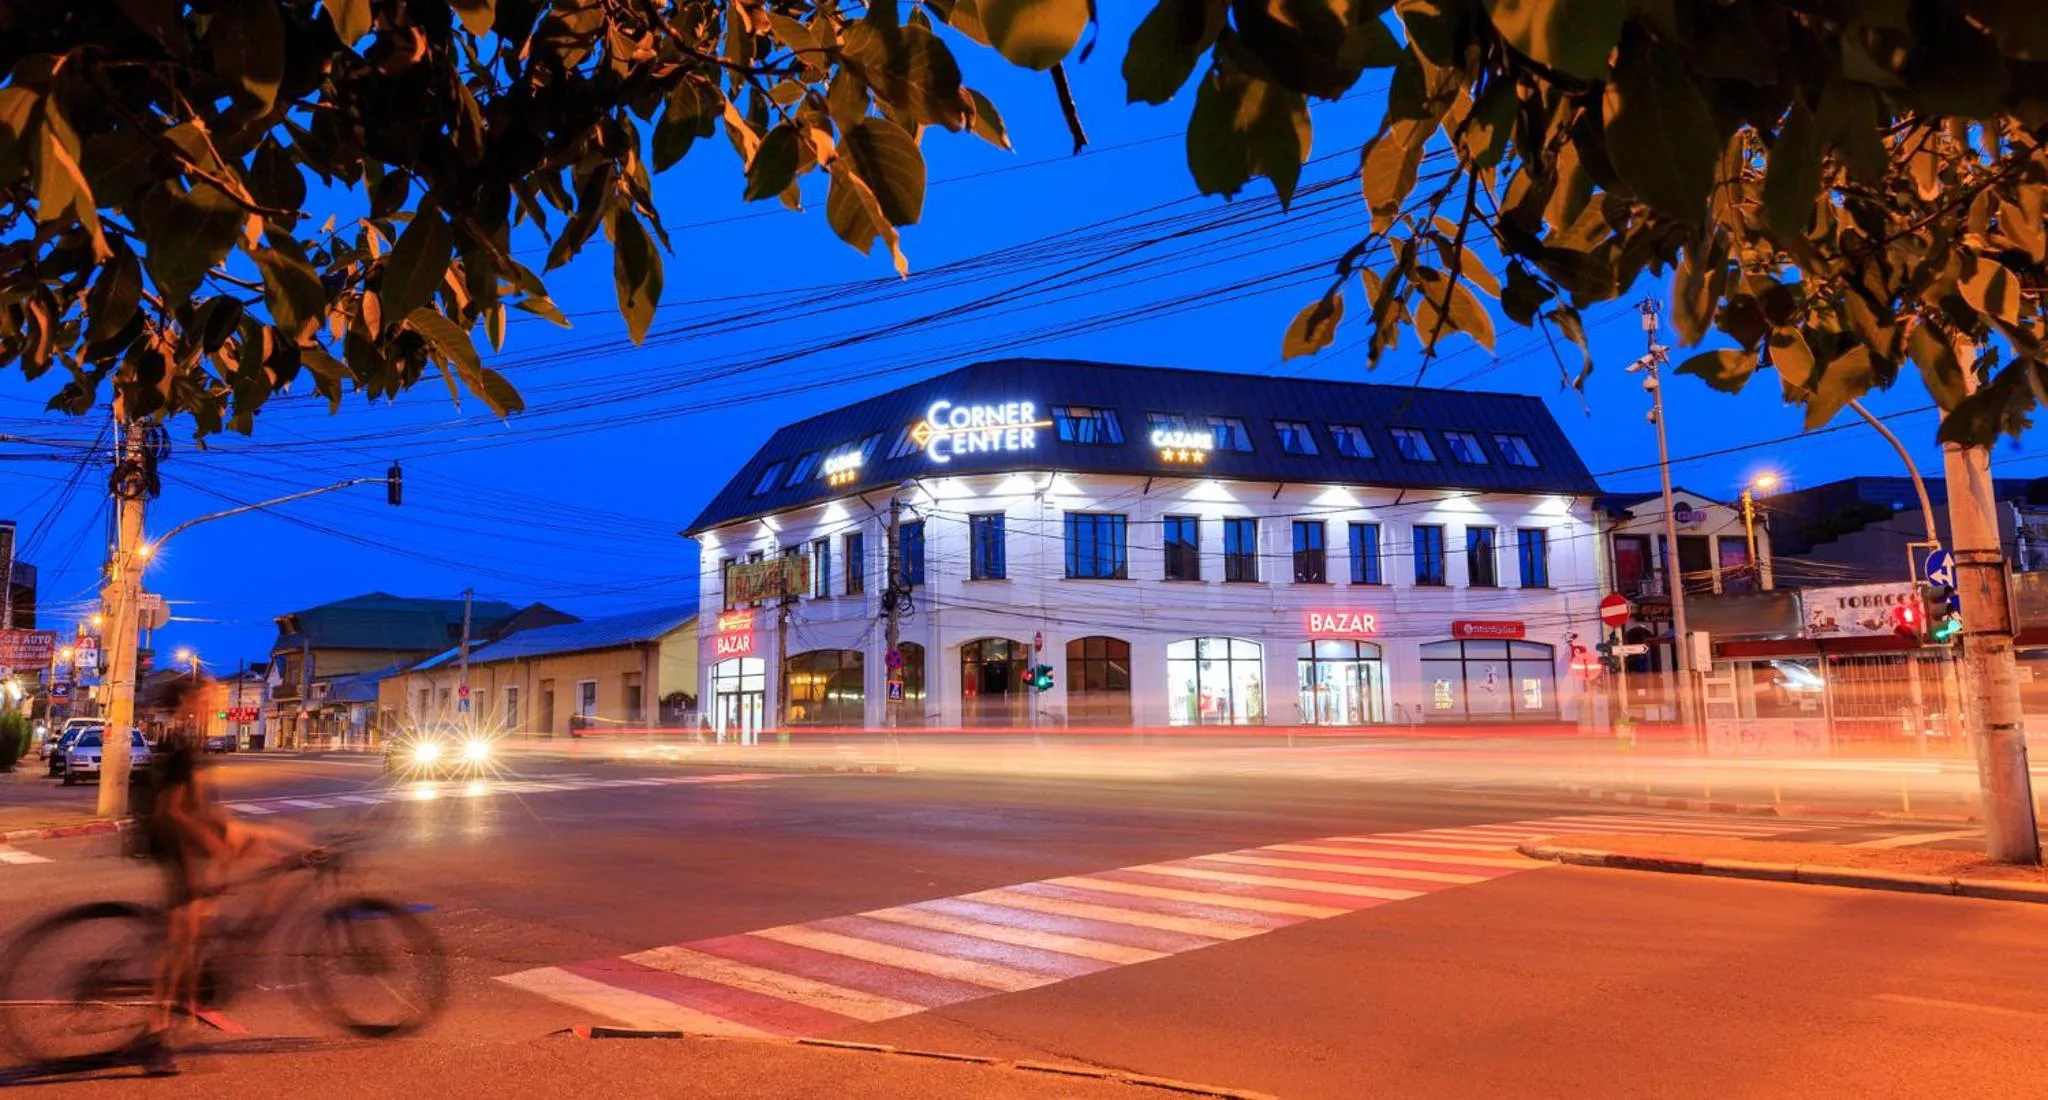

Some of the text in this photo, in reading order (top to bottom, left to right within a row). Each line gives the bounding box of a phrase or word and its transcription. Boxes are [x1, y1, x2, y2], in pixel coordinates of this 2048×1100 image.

[927, 400, 1035, 428] CORNER
[926, 429, 1035, 461] CENTER
[1310, 613, 1376, 632] BAZAR
[22, 634, 52, 645] AUTO
[717, 635, 751, 654] BAZAR
